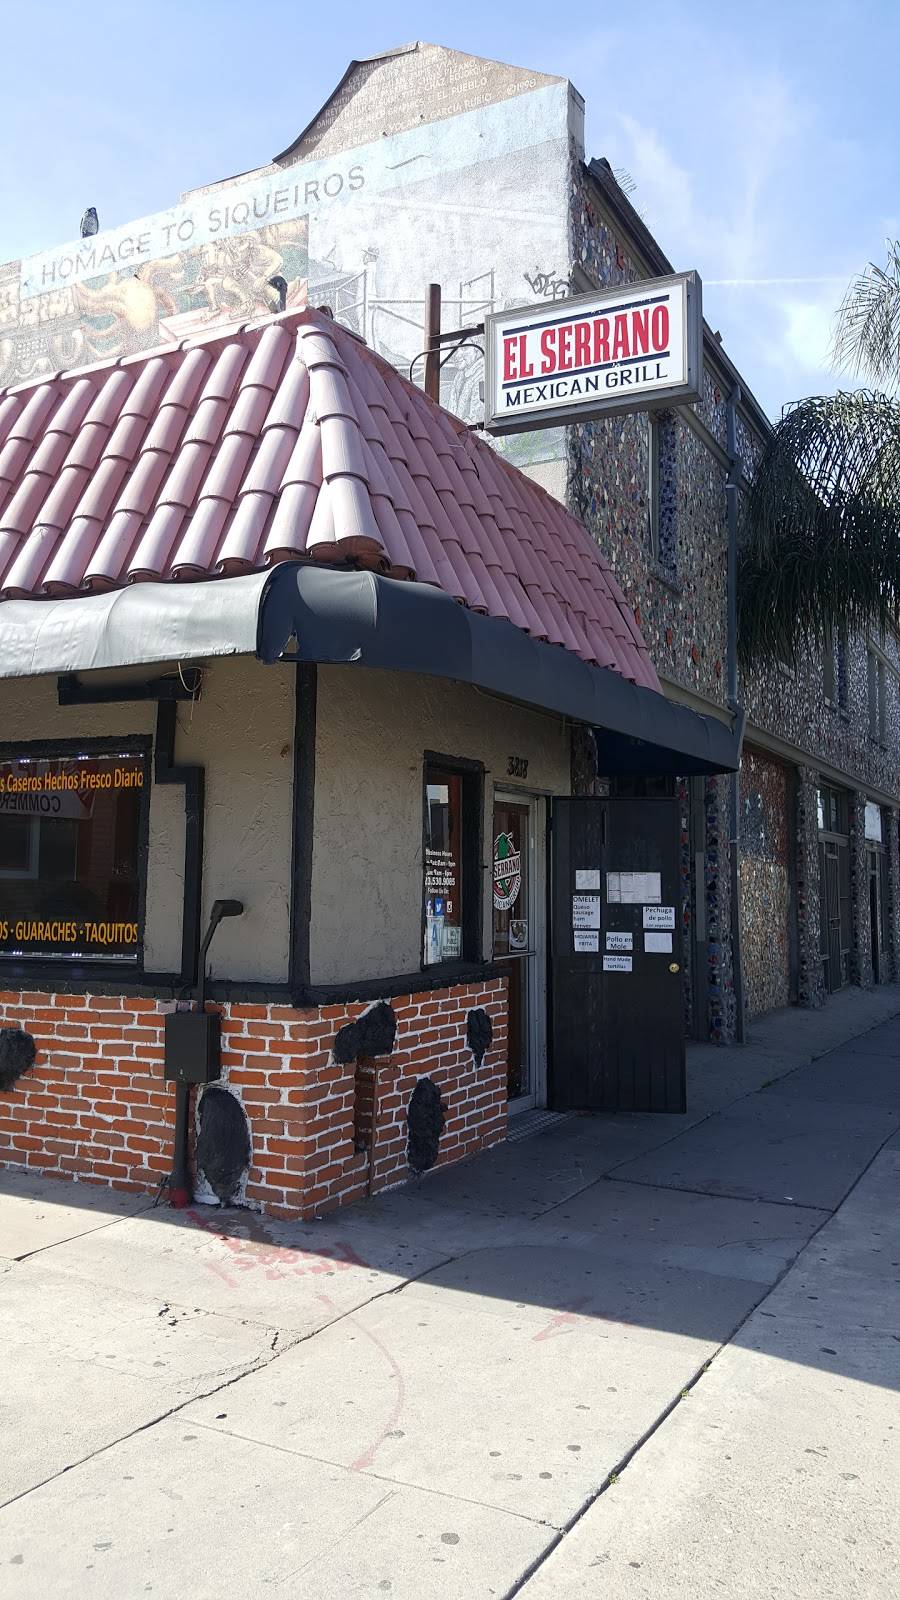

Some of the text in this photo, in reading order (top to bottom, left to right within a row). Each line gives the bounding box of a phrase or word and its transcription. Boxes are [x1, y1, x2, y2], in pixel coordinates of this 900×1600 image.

[452, 76, 486, 95] PUEBLO
[41, 166, 365, 285] HOMAGE TO SIQUEIROS
[503, 305, 669, 381] EL SERRANO
[506, 363, 668, 407] MEXICAN GRILL
[7, 775, 41, 792] Caseros
[45, 771, 79, 790] Hechos
[80, 770, 111, 789] Fresco
[114, 767, 143, 788] Diario
[494, 858, 520, 878] SERRANO
[645, 907, 673, 915] Pechuga
[15, 921, 77, 941] GUARACHES
[85, 923, 138, 944] TAQUITOS
